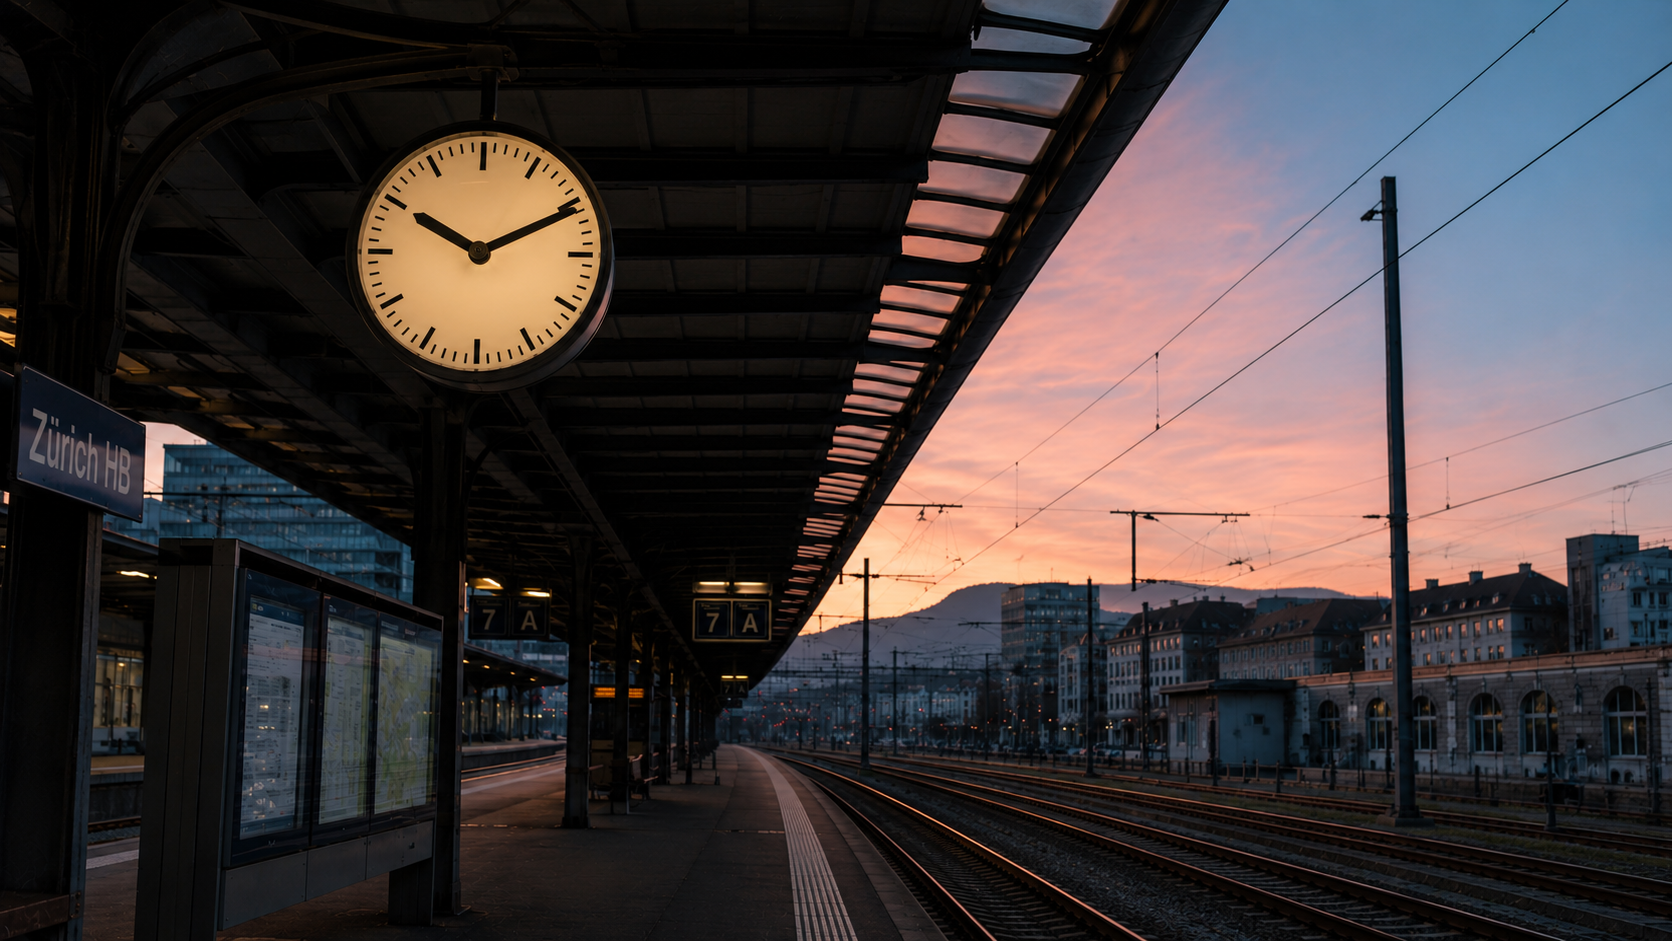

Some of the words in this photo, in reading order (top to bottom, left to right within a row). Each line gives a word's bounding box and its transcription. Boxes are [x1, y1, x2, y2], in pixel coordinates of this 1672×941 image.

[29, 408, 98, 484] Zürich
[105, 440, 131, 495] HB
[482, 608, 497, 631] 7
[520, 609, 539, 631] A
[706, 612, 720, 633] 7
[741, 612, 759, 633] A
[724, 684, 731, 694] 7
